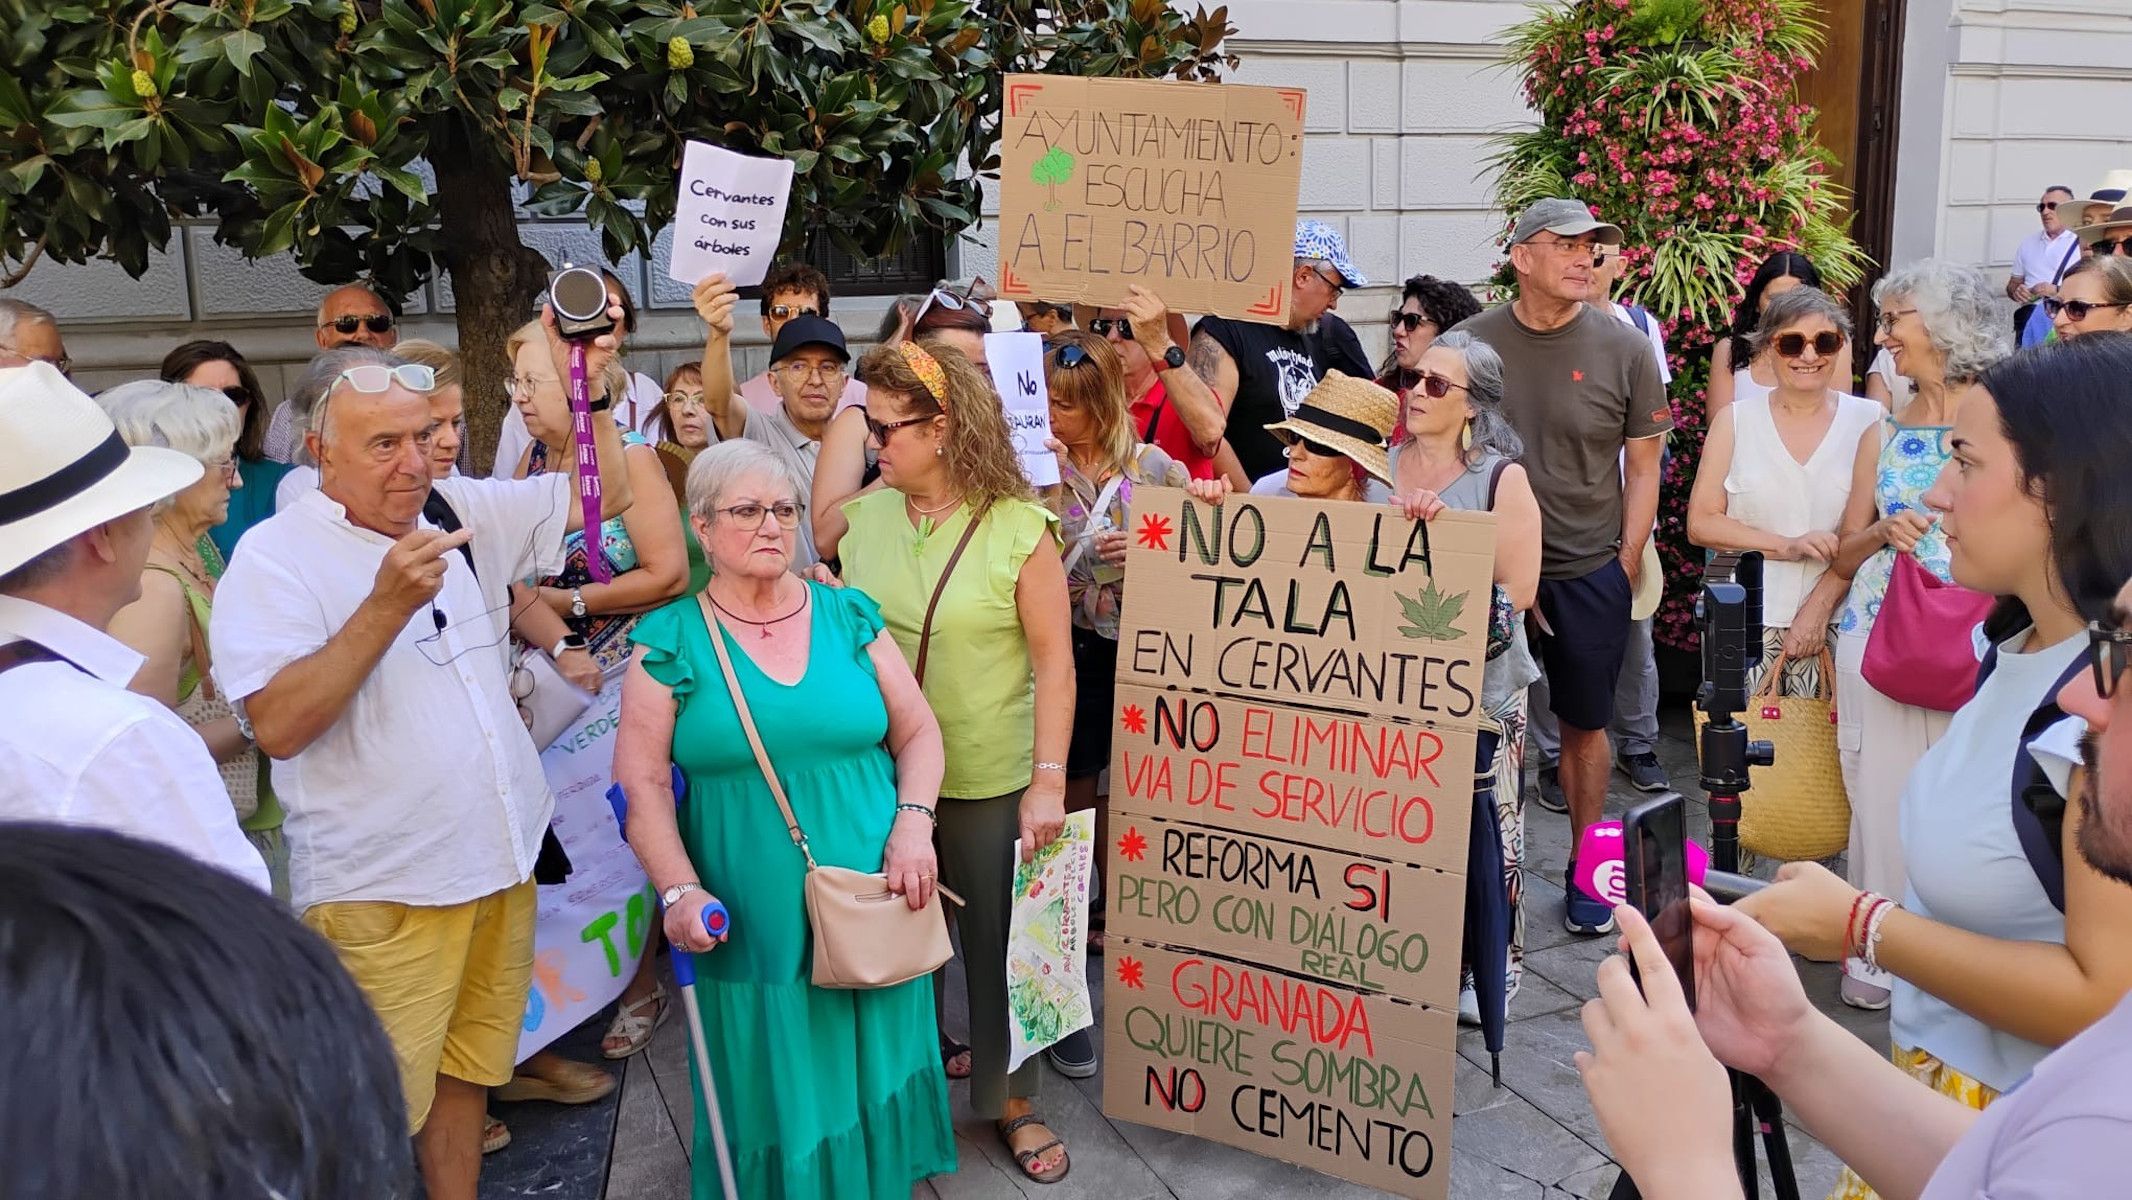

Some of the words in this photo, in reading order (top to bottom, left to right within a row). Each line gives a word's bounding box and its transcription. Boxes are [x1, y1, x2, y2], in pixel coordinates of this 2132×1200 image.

[1015, 109, 1298, 165] AYUNTAMIENTO:
[690, 179, 775, 206] Cervantes
[700, 213, 727, 228] con
[731, 218, 756, 230] sus
[1085, 164, 1227, 219] ESCUCHA
[694, 235, 751, 256] árboles
[1012, 213, 1045, 271] A
[1063, 213, 1111, 274] EL
[1120, 220, 1256, 283] BARRIO
[1017, 369, 1037, 397] No
[1179, 500, 1266, 567] NO
[1300, 511, 1336, 573] A
[1363, 512, 1433, 578] LA
[1190, 574, 1356, 641] TALA
[1133, 630, 1193, 678] EN
[1217, 636, 1475, 718] CERVANTES
[1153, 695, 1220, 752] NO
[1241, 708, 1444, 788] ELIMINAR
[1123, 751, 1173, 802] VIA
[1187, 758, 1241, 812] DE
[1252, 770, 1435, 845] SERVICIO
[1117, 873, 1200, 925] PERO
[1212, 894, 1274, 941] CON
[1162, 828, 1321, 899] REFORMA
[1343, 863, 1391, 923] SI
[1300, 949, 1384, 990] REAL
[1171, 959, 1374, 1058] GRANADA
[1124, 1005, 1255, 1076] QUIERE
[1271, 1039, 1435, 1120] SOMBRA
[1144, 1065, 1206, 1112] NO
[1231, 1084, 1434, 1178] CEMENTO
